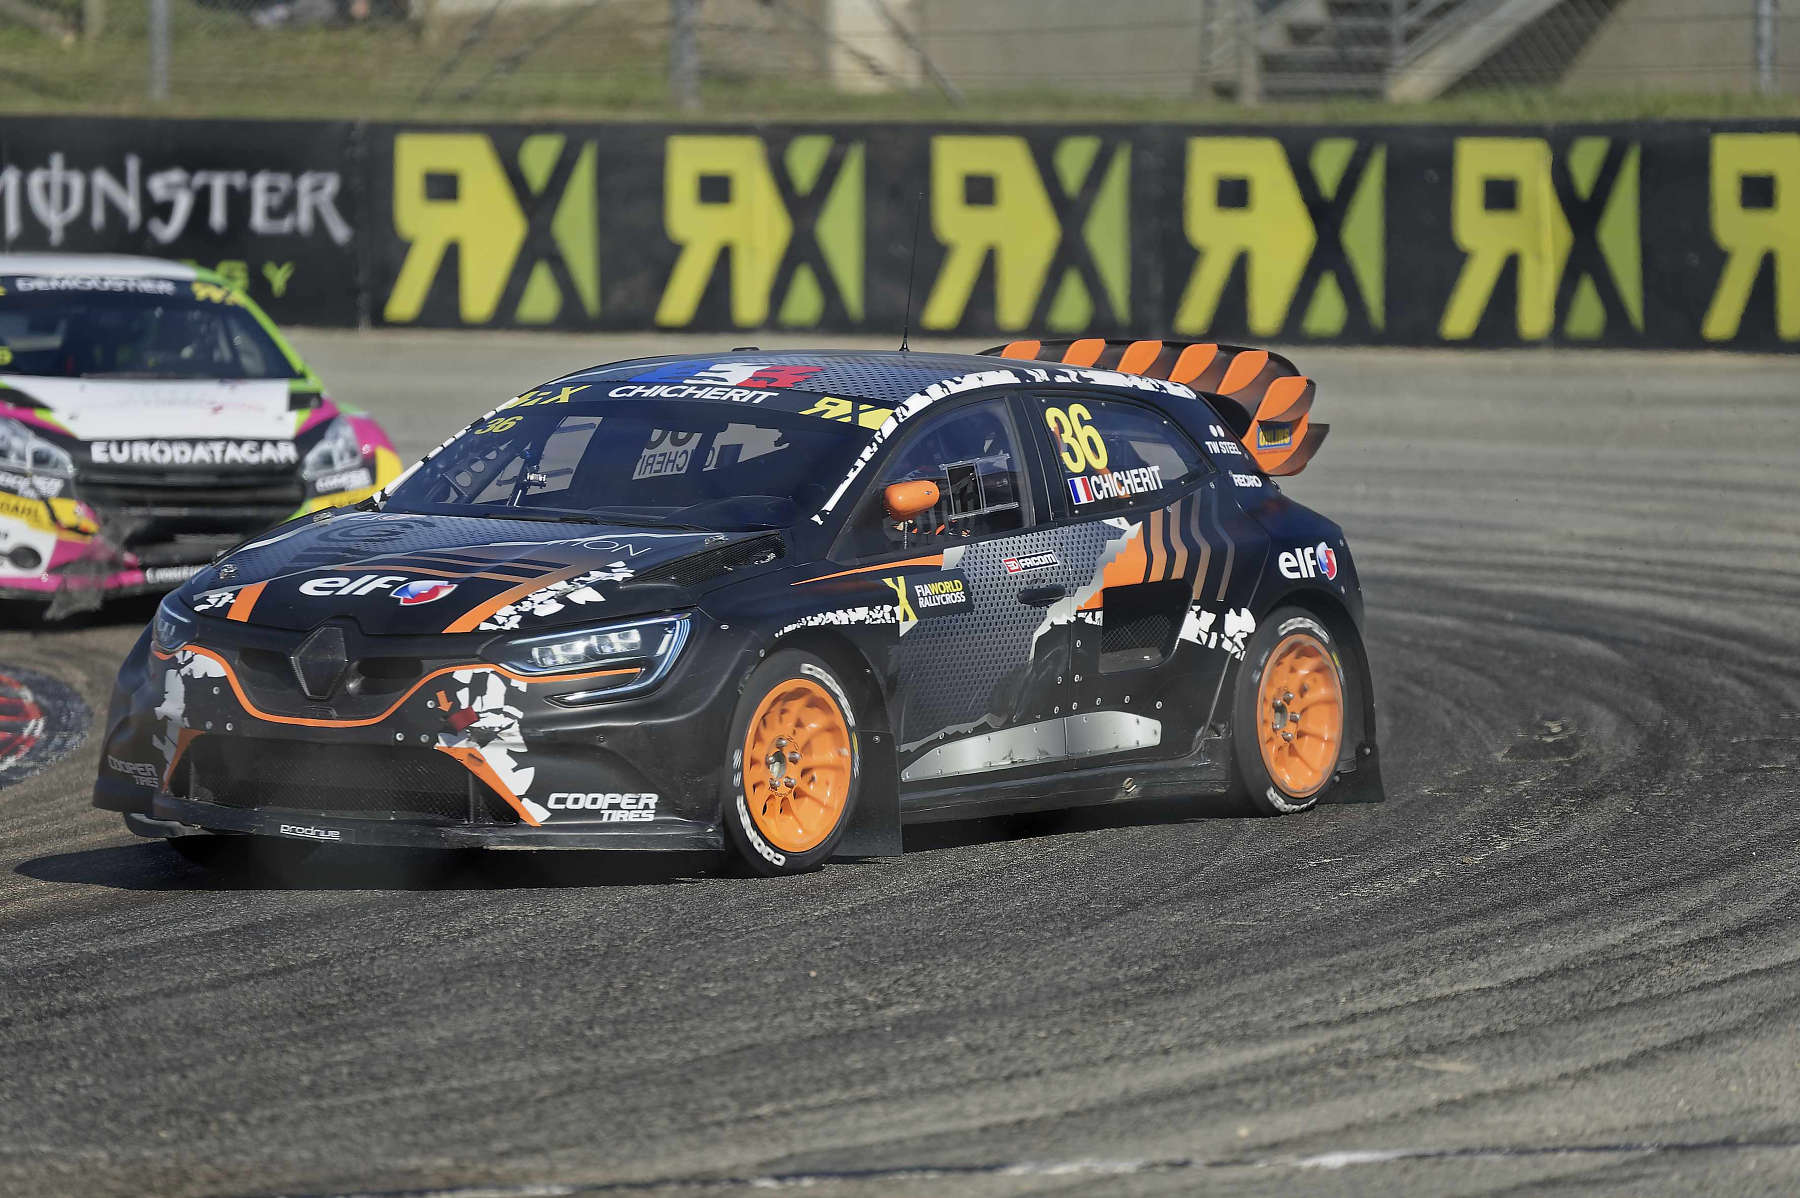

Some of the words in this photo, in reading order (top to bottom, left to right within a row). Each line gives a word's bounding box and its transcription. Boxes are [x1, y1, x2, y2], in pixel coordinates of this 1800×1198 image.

[608, 385, 779, 404] CHICHERIT
[475, 415, 523, 435] 36
[1045, 403, 1108, 473] 36
[90, 440, 298, 465] EURODATACAR
[1220, 441, 1241, 455] STEEL
[1090, 465, 1163, 500] CHICHERIT
[1019, 554, 1056, 570] FACOM
[1278, 546, 1317, 579] elf
[299, 574, 408, 597] elf
[918, 591, 966, 608] RALLYCROSS
[547, 792, 659, 810] COOPER
[600, 809, 656, 822] TIRES
